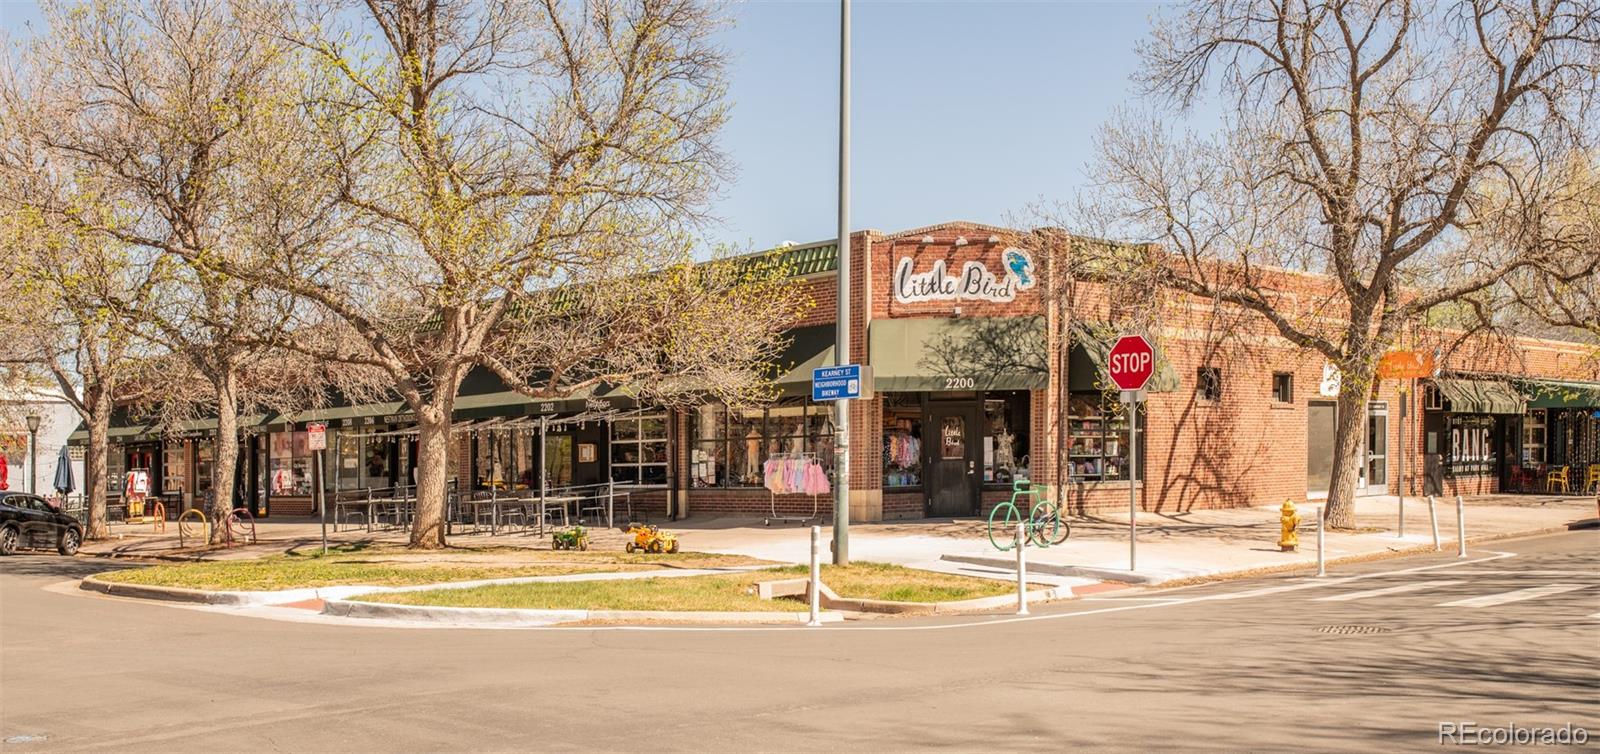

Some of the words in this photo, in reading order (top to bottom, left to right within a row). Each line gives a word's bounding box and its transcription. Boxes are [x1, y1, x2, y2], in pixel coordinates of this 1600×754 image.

[899, 261, 955, 299] Little
[963, 266, 1011, 298] Bird
[1112, 352, 1150, 374] STOP
[821, 369, 844, 377] KEARNEY
[845, 368, 852, 376] ST
[815, 379, 847, 388] NEIGHBORHOOD
[945, 377, 975, 389] 2200
[821, 389, 840, 397] BIKEWAY
[540, 402, 554, 412] 2202
[945, 425, 961, 437] Little
[946, 437, 960, 447] Bird
[1452, 428, 1489, 462] BANG
